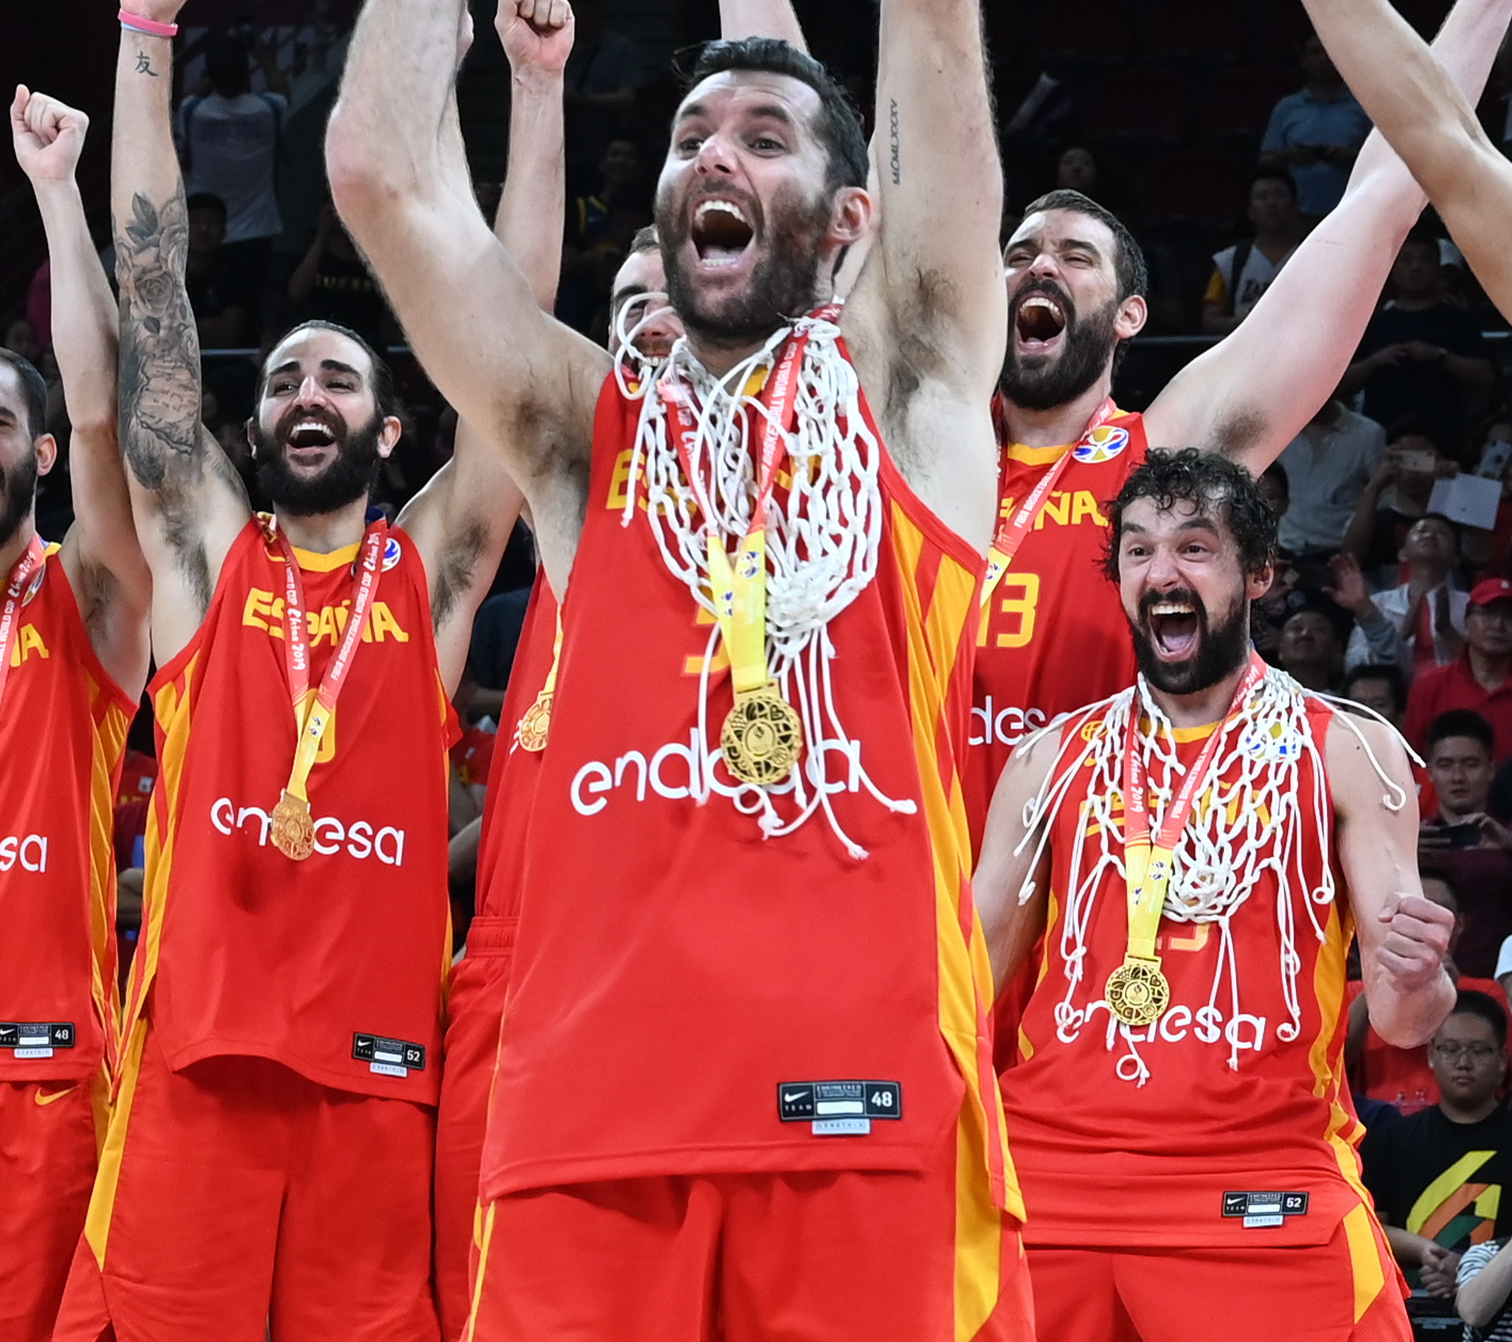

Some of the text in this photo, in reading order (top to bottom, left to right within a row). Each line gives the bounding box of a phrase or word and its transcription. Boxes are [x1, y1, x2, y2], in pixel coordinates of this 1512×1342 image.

[772, 360, 793, 398] WORLD
[288, 608, 302, 641] China
[292, 643, 306, 671] 2019
[330, 664, 345, 681] FIBA
[1130, 786, 1144, 812] 2019
[210, 797, 405, 866] enesa
[55, 1029, 69, 1040] 48
[407, 1050, 420, 1062] 52
[871, 1091, 893, 1107] 48
[1286, 1197, 1302, 1208] 52
